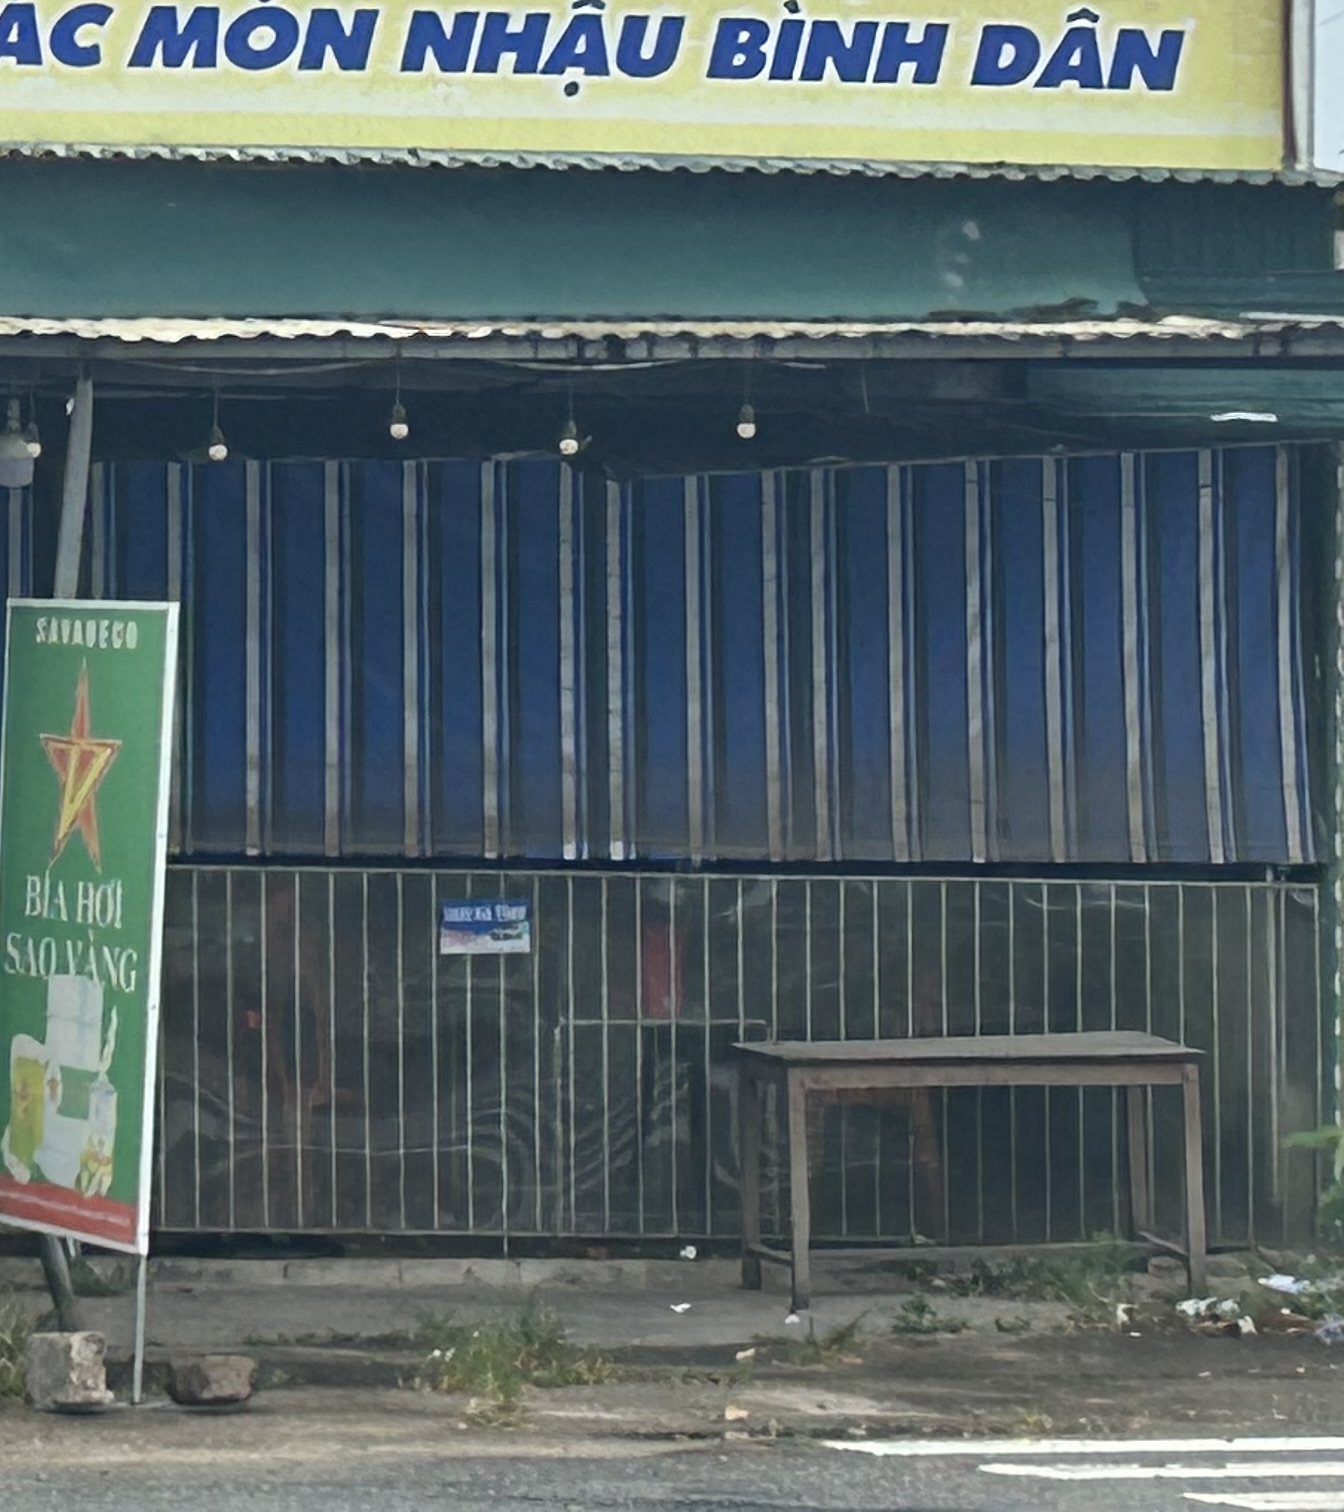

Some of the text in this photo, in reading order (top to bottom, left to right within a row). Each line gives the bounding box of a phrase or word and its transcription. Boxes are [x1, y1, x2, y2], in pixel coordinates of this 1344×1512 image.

[970, 7, 1185, 91] DÂN
[25, 870, 68, 921] BIA
[4, 932, 57, 979] SAO
